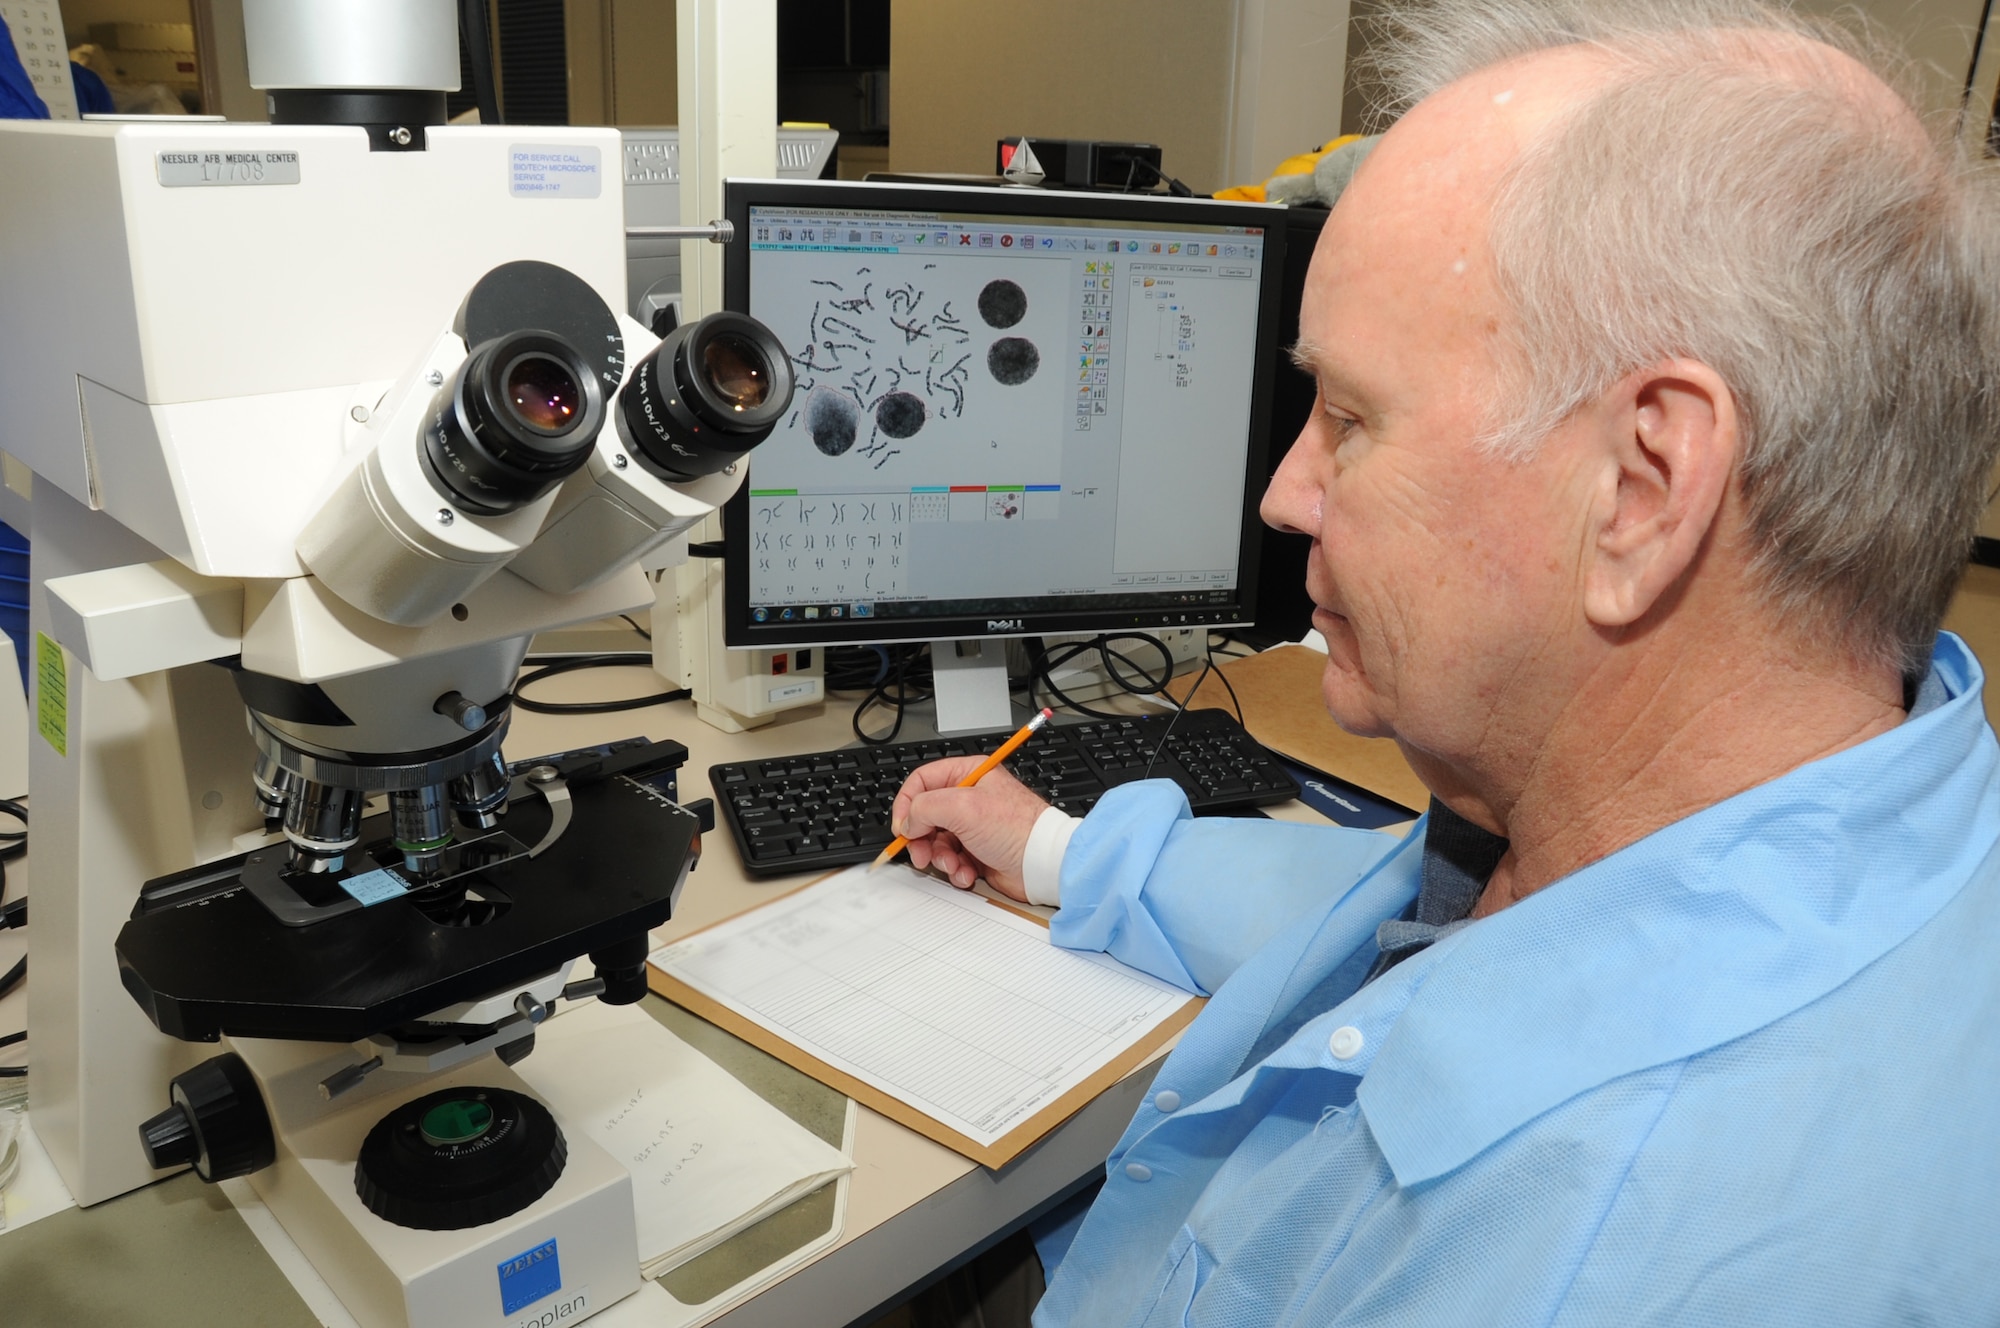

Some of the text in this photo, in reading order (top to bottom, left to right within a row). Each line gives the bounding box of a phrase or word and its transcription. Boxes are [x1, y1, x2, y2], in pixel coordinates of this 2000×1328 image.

[22, 9, 29, 18] 2
[48, 60, 61, 68] 24
[162, 153, 297, 164] KEESLER AFB MEDICAL CENTER
[530, 154, 561, 162] SERVICE
[201, 163, 264, 181] 17708
[548, 164, 596, 173] MICROSCOPE
[608, 356, 616, 364] 65
[987, 620, 1024, 631] DELL
[502, 1244, 556, 1280] ZEISS
